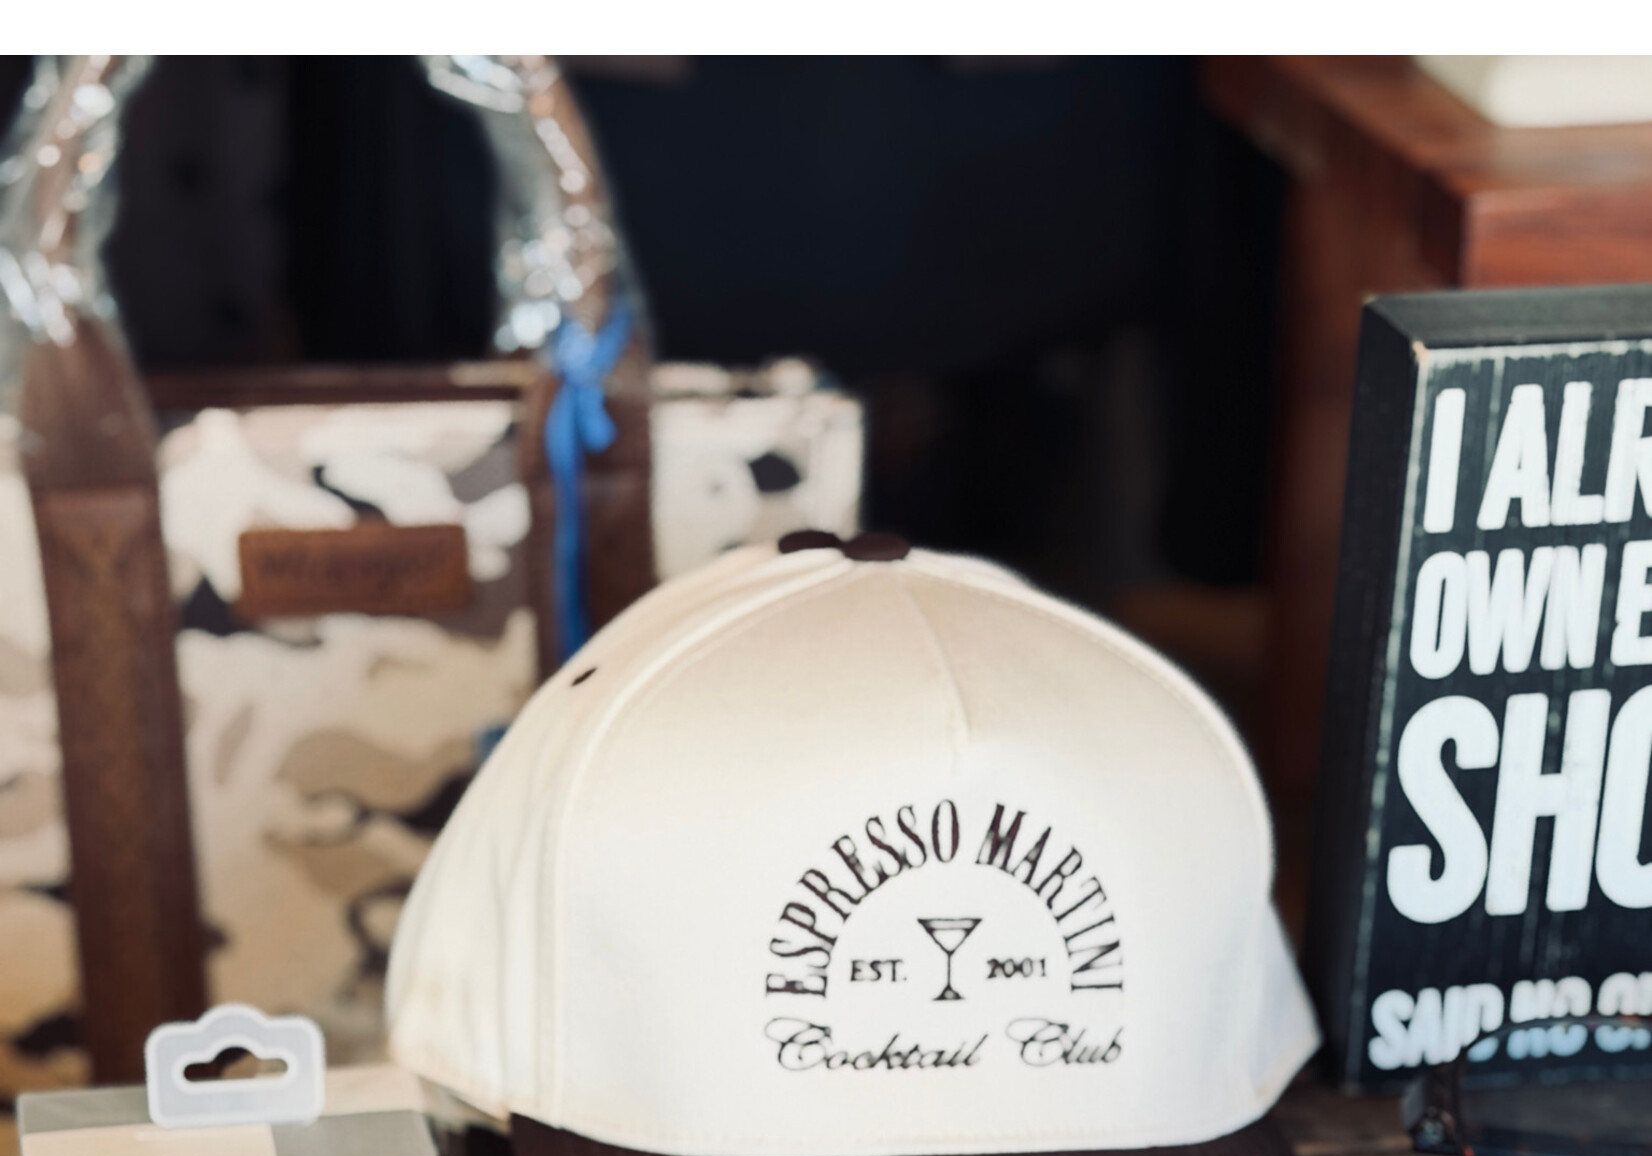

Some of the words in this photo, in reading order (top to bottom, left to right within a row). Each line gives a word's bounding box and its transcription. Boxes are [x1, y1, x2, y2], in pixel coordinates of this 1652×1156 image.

[1424, 388, 1466, 533] I
[1410, 544, 1607, 679] OWN
[765, 799, 960, 998] ESPRESSO
[975, 803, 1123, 993] MARTINI
[850, 959, 908, 982] EST.
[986, 957, 1047, 980] 2001
[764, 1017, 989, 1071] Cocktail
[1005, 1016, 1124, 1067] Club
